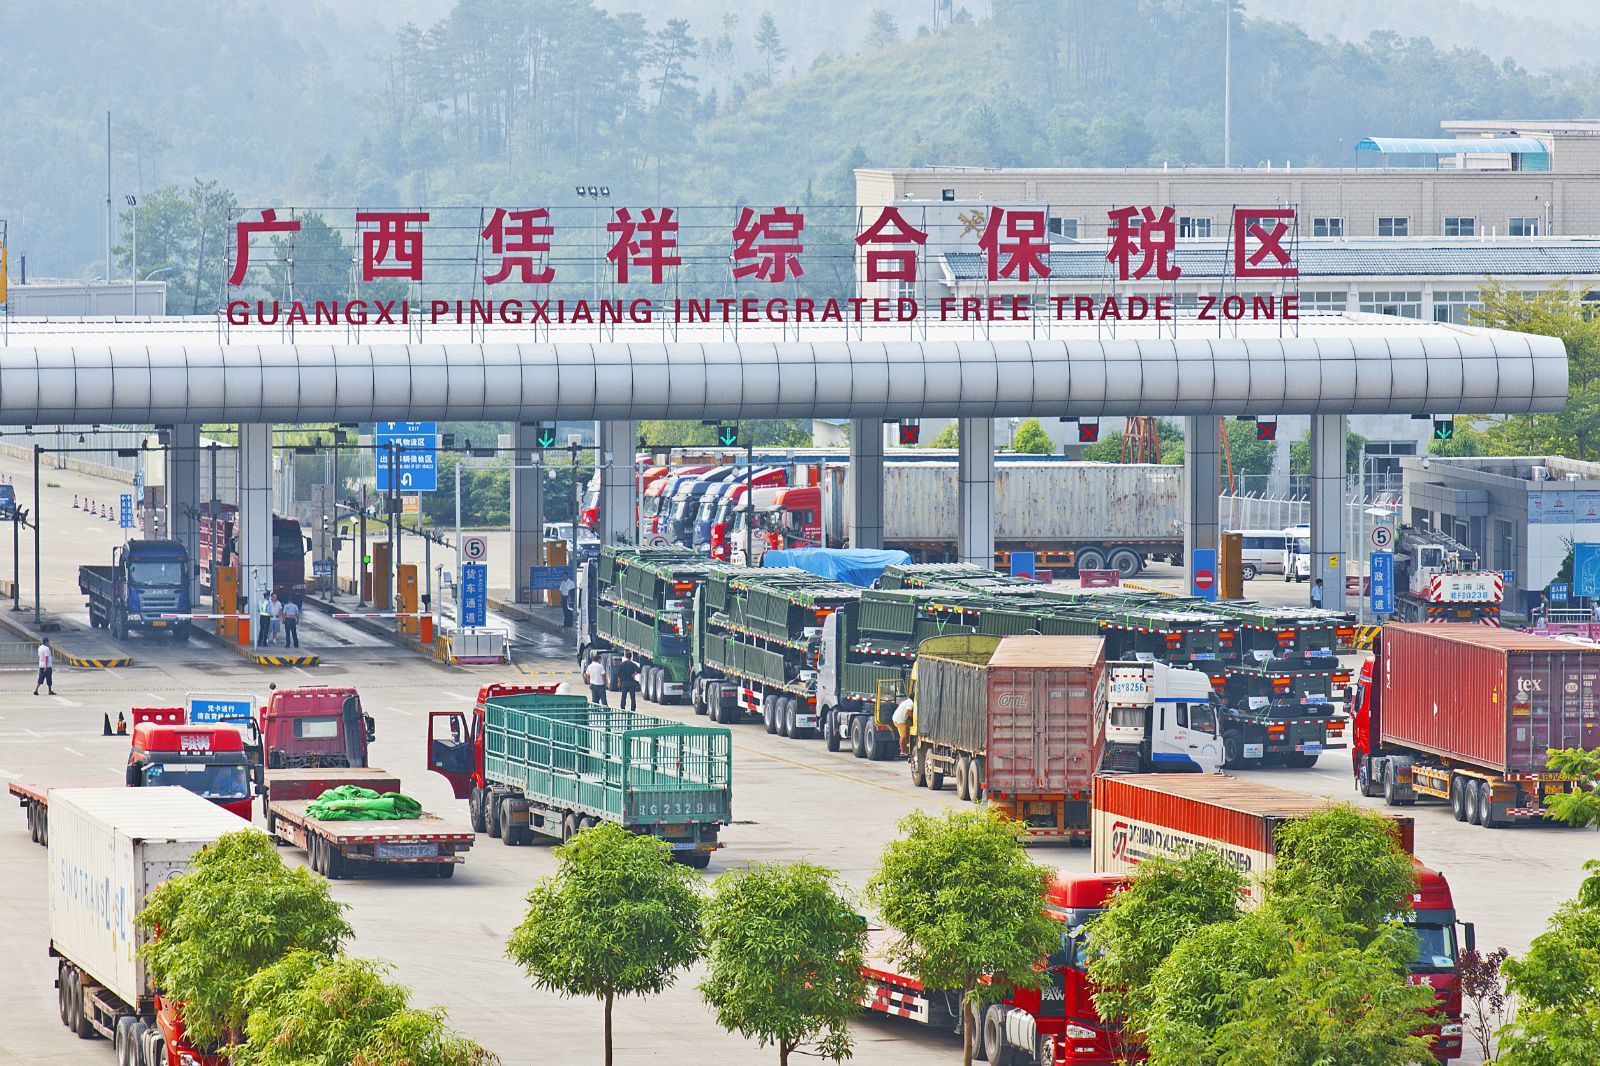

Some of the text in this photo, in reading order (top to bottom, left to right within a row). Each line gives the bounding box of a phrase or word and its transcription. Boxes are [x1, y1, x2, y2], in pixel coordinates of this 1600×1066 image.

[229, 207, 1297, 286] 广西凭祥综合保税区
[227, 296, 1297, 325] GUANGXI PINGXIANG INTEGRATED FREE TRADE ZONE
[1377, 530, 1387, 544] 5
[470, 541, 480, 556] 5
[1374, 557, 1384, 610] 行政通道
[466, 568, 476, 622] 货车通道
[1517, 676, 1541, 691] tex
[181, 735, 210, 751] FAW
